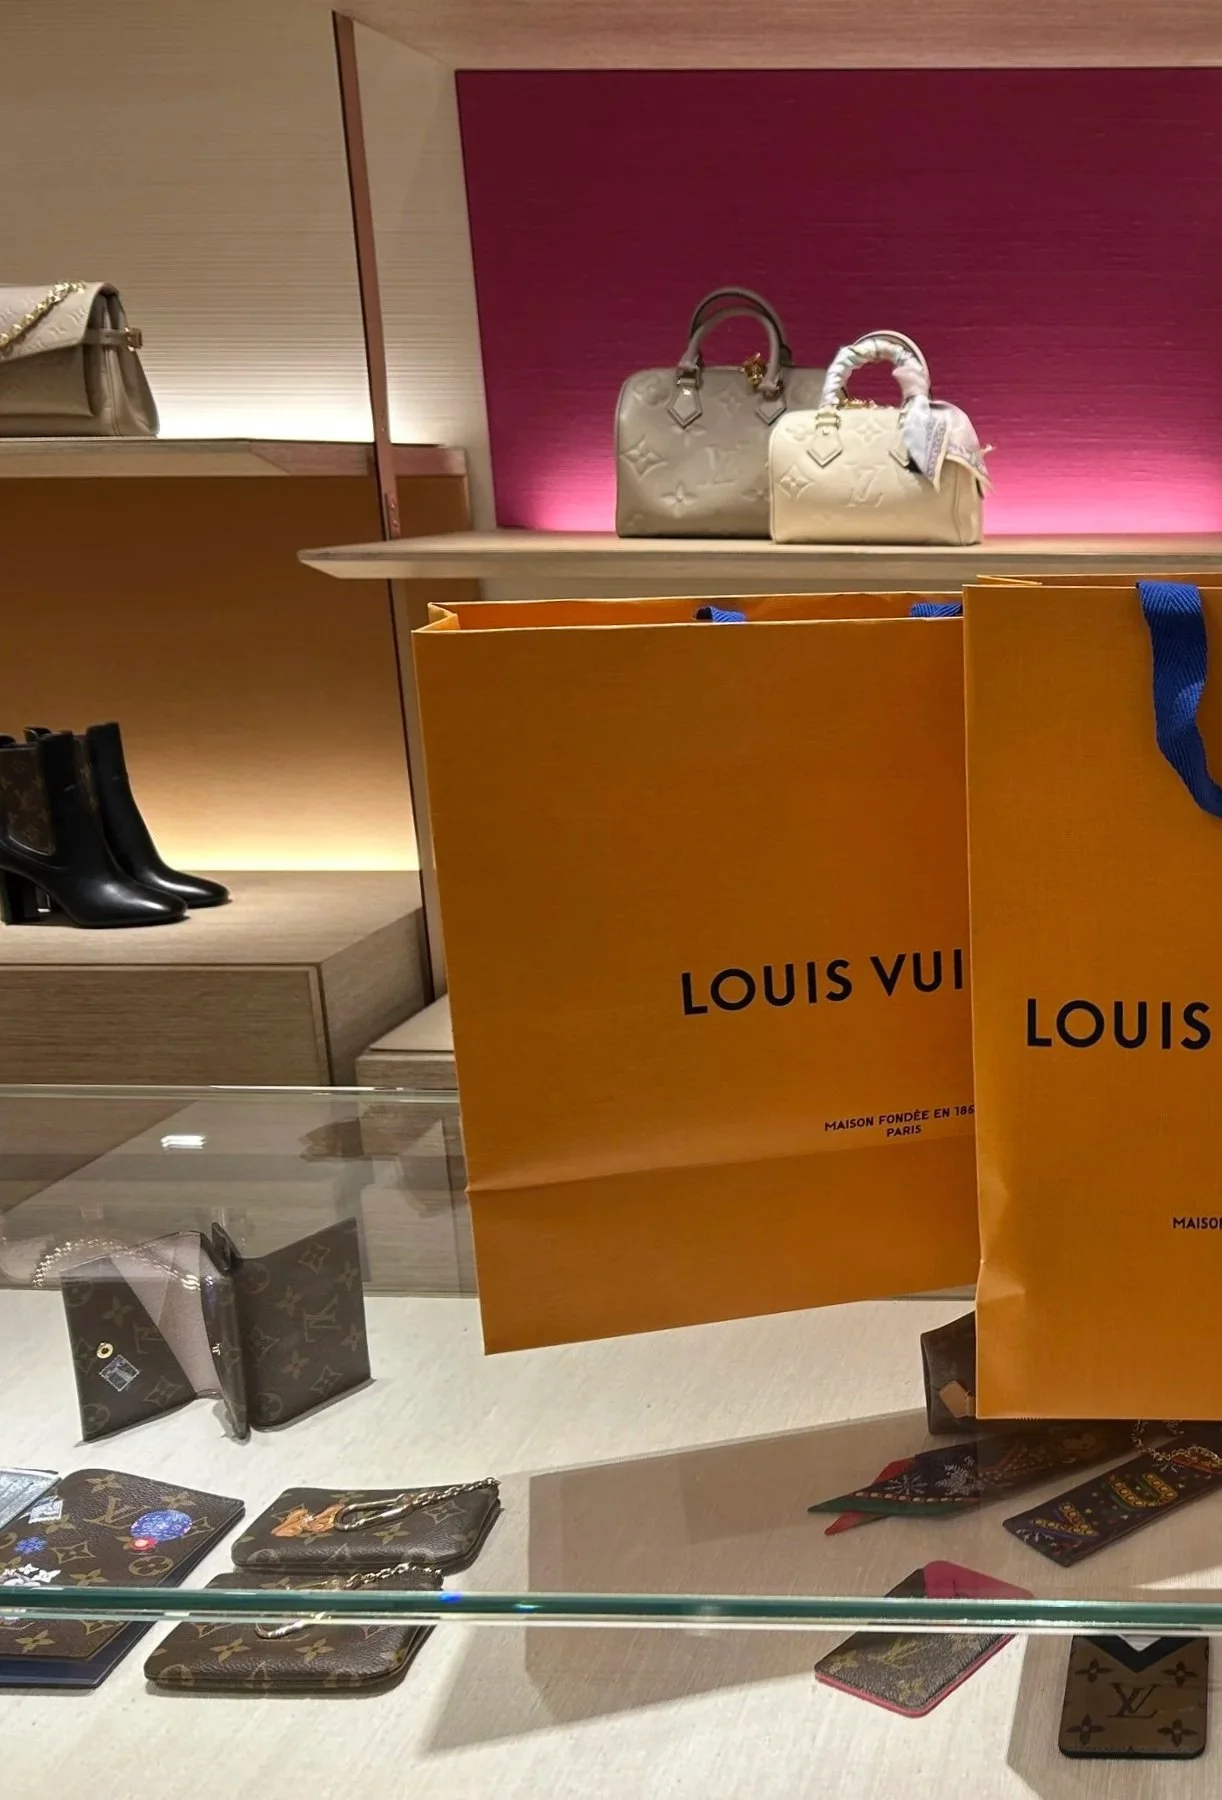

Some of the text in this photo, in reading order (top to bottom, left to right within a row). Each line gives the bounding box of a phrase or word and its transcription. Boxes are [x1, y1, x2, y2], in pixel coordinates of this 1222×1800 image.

[681, 959, 853, 1015] LOUIS
[1026, 998, 1213, 1050] LOUIS
[824, 1116, 874, 1131] MAISON
[878, 1109, 930, 1126] FONDÉE
[933, 1107, 951, 1119] EN
[886, 1125, 922, 1138] PARIS
